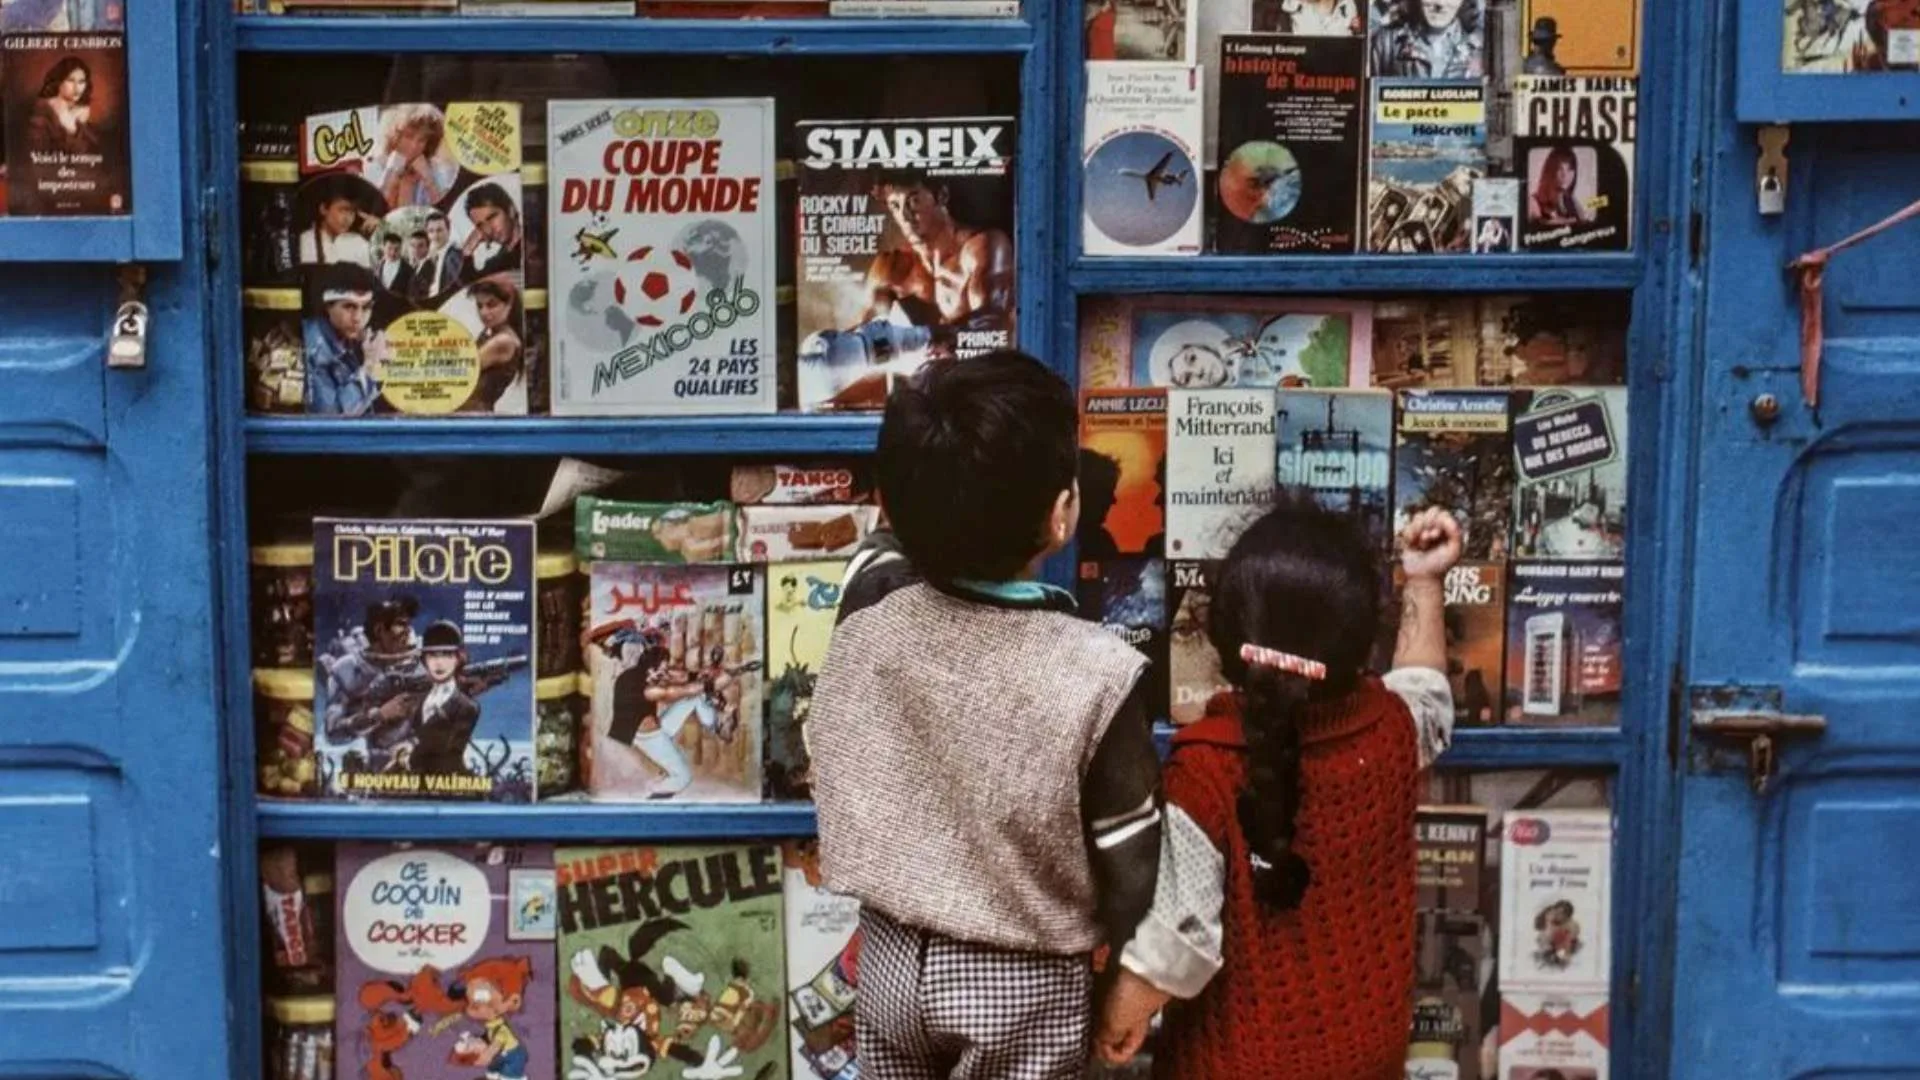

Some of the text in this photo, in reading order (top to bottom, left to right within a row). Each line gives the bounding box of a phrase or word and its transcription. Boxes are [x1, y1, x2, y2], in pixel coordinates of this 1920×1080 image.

[4, 36, 58, 49] GILBERT
[1225, 56, 1297, 74] histoire
[1266, 72, 1357, 93] de Rampa
[1530, 78, 1577, 92] JAMES
[1382, 90, 1428, 99] ROBERT
[612, 108, 720, 137] onze
[1383, 105, 1449, 121] Le pacte
[1528, 95, 1637, 142] CHASE
[1411, 123, 1477, 137] Holcroft
[603, 139, 723, 176] COUPE
[803, 126, 1004, 170] STARFIX
[57, 166, 76, 178] des
[560, 178, 761, 214] DU MONDE
[800, 195, 868, 214] ROCKY IV
[800, 214, 886, 234] LE COMBAT
[800, 235, 879, 255] DU SIECLE
[729, 338, 758, 356] LES
[956, 330, 1009, 348] PRINCE
[688, 357, 759, 376] 24 PAYS
[673, 378, 759, 397] QUALIFIES
[1087, 397, 1127, 412] ANNIE
[1187, 396, 1264, 418] François
[1408, 397, 1458, 411] Christine
[1175, 415, 1276, 437] Mitterrand
[1212, 446, 1234, 465] Ici
[1544, 446, 1566, 465] DES
[778, 469, 852, 487] TANGO
[1215, 467, 1233, 484] et
[592, 510, 652, 535] Leader
[333, 534, 512, 585] Pilote
[354, 772, 419, 789] NOUVEAU
[424, 771, 492, 791] VALÉRIAN
[1428, 823, 1478, 842] KENNY
[1417, 849, 1475, 863] PLAN
[400, 861, 428, 882] CE
[556, 849, 658, 886] SUPER
[371, 878, 461, 907] COQUIN
[557, 845, 783, 935] HERCULE
[367, 920, 467, 945] COCKER
